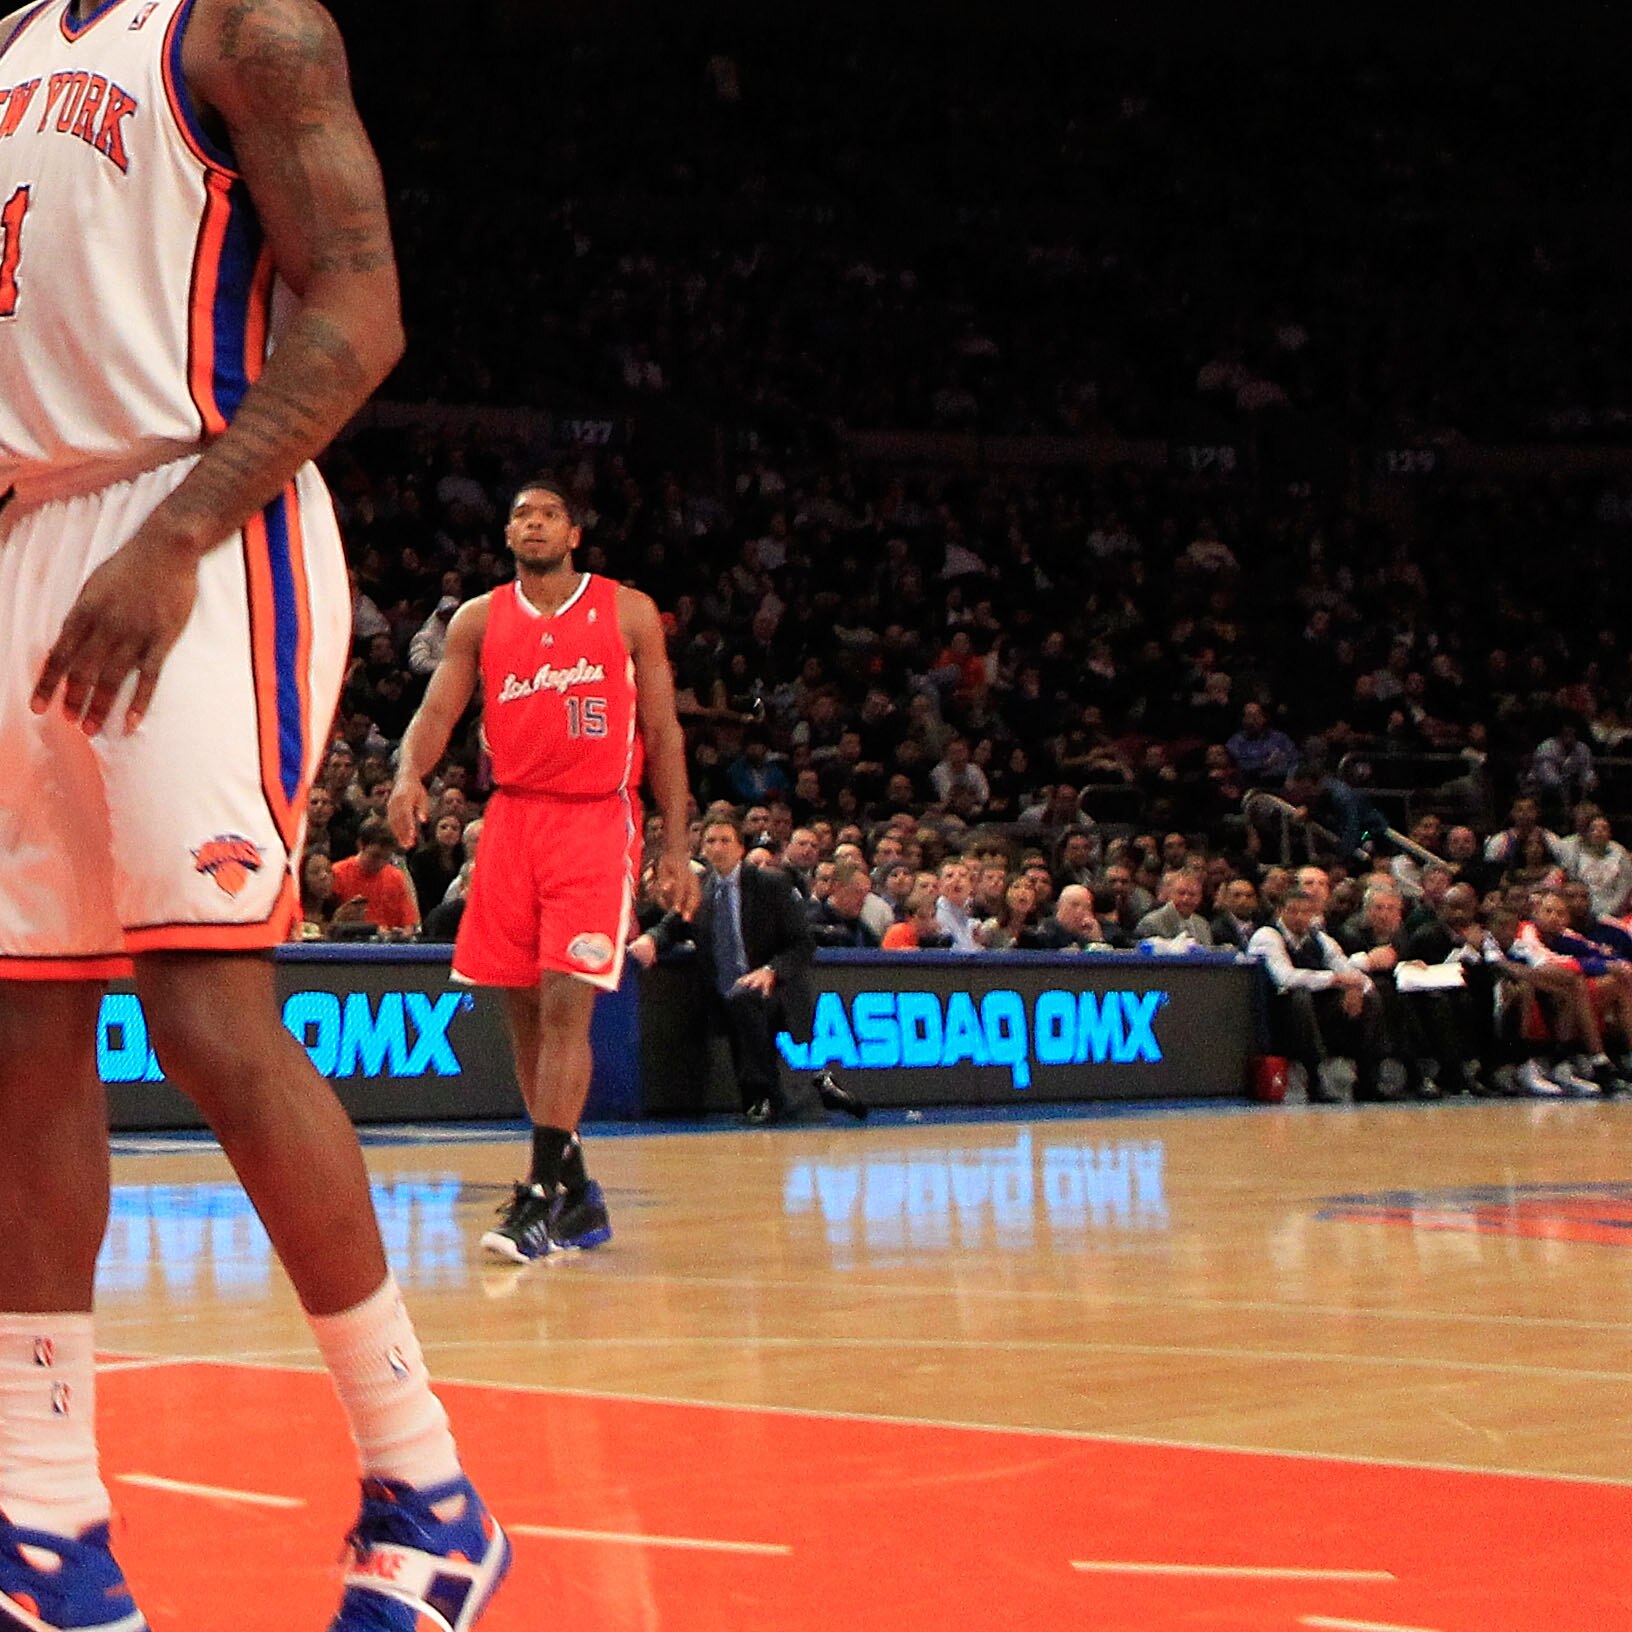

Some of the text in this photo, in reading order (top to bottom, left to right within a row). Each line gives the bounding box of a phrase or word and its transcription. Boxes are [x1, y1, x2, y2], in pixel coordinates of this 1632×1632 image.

[37, 70, 137, 175] YORK
[497, 655, 606, 704] Los Angeles
[564, 695, 608, 738] 15
[1035, 989, 1164, 1065] OMX
